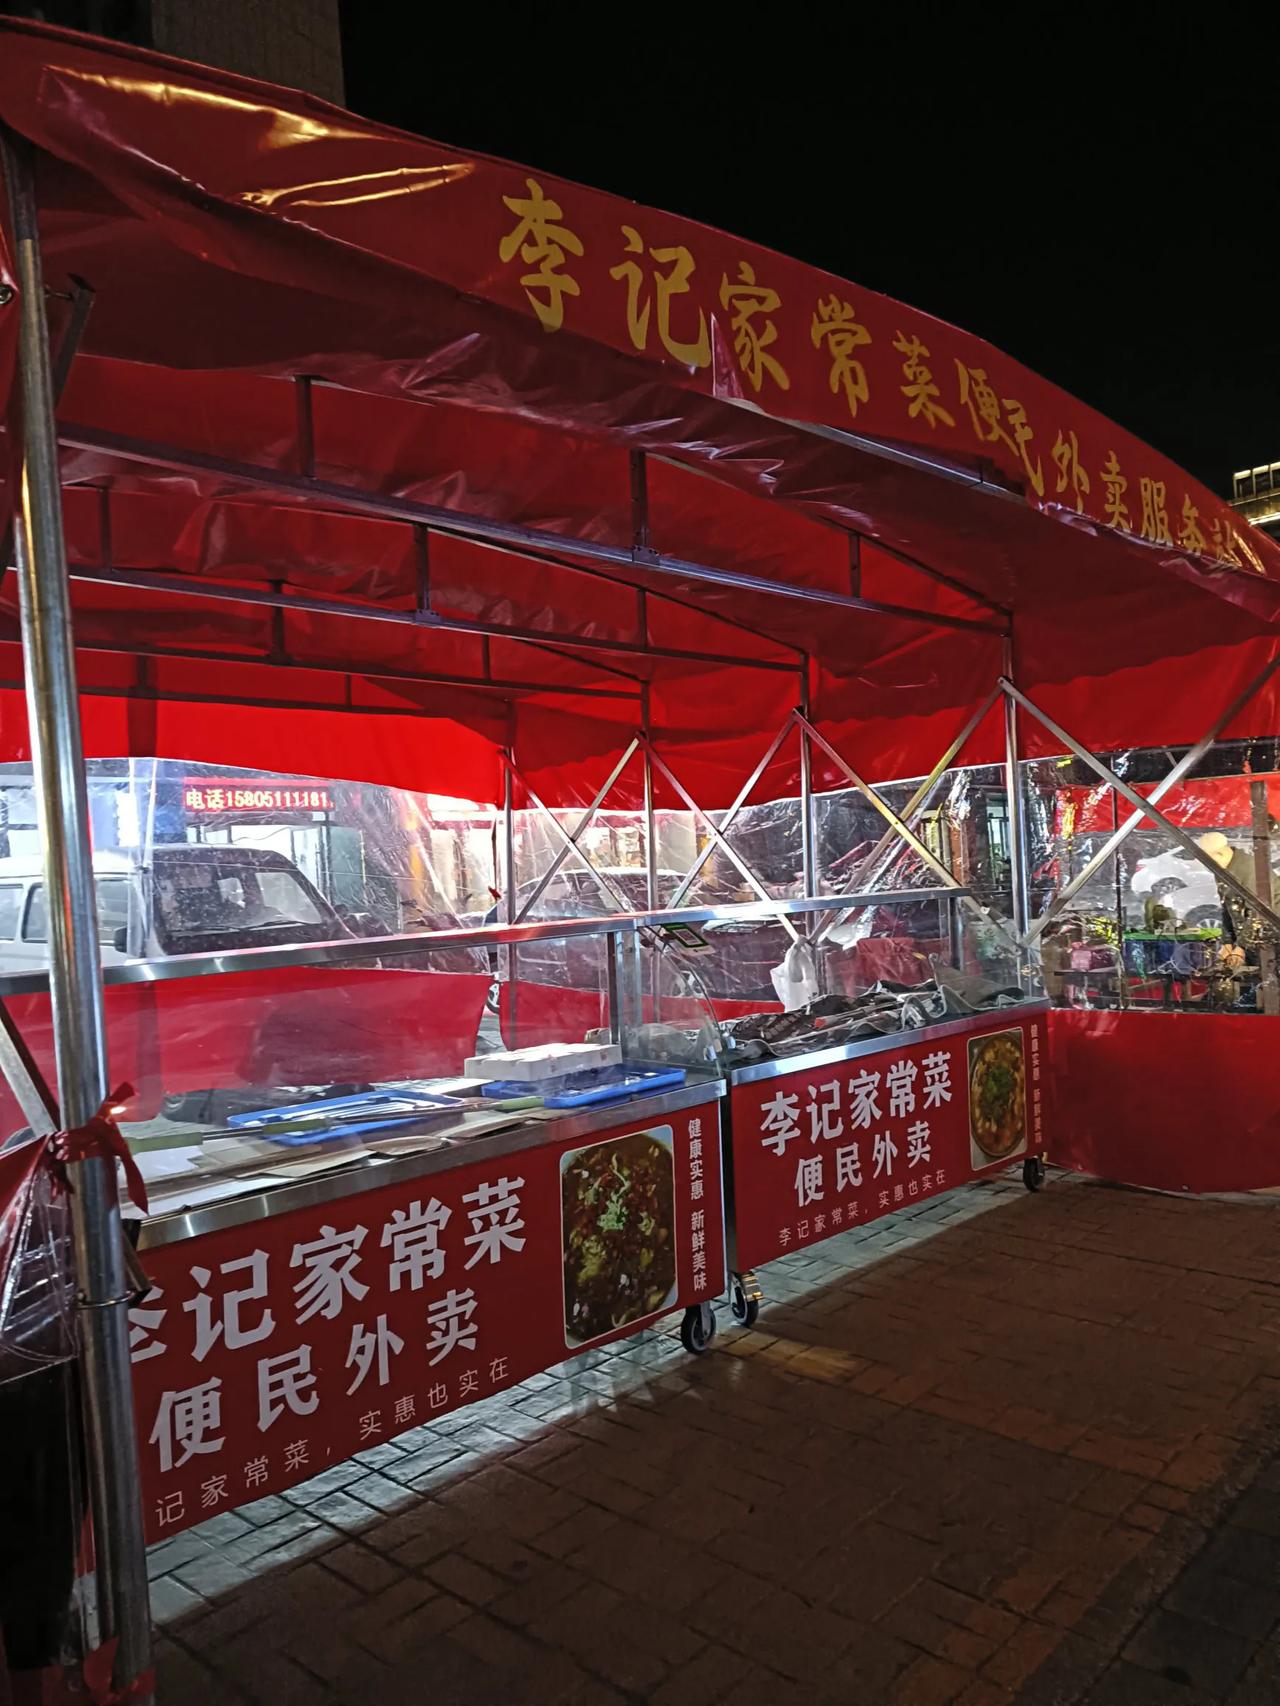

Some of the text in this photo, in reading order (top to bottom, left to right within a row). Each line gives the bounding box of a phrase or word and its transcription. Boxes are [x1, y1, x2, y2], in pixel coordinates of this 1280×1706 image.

[760, 1051, 952, 1156] 李记家常菜
[794, 1120, 931, 1207] 便民外卖
[688, 1118, 707, 1291] 健康实惠 新鲜美味
[149, 1288, 478, 1472] 便民外卖
